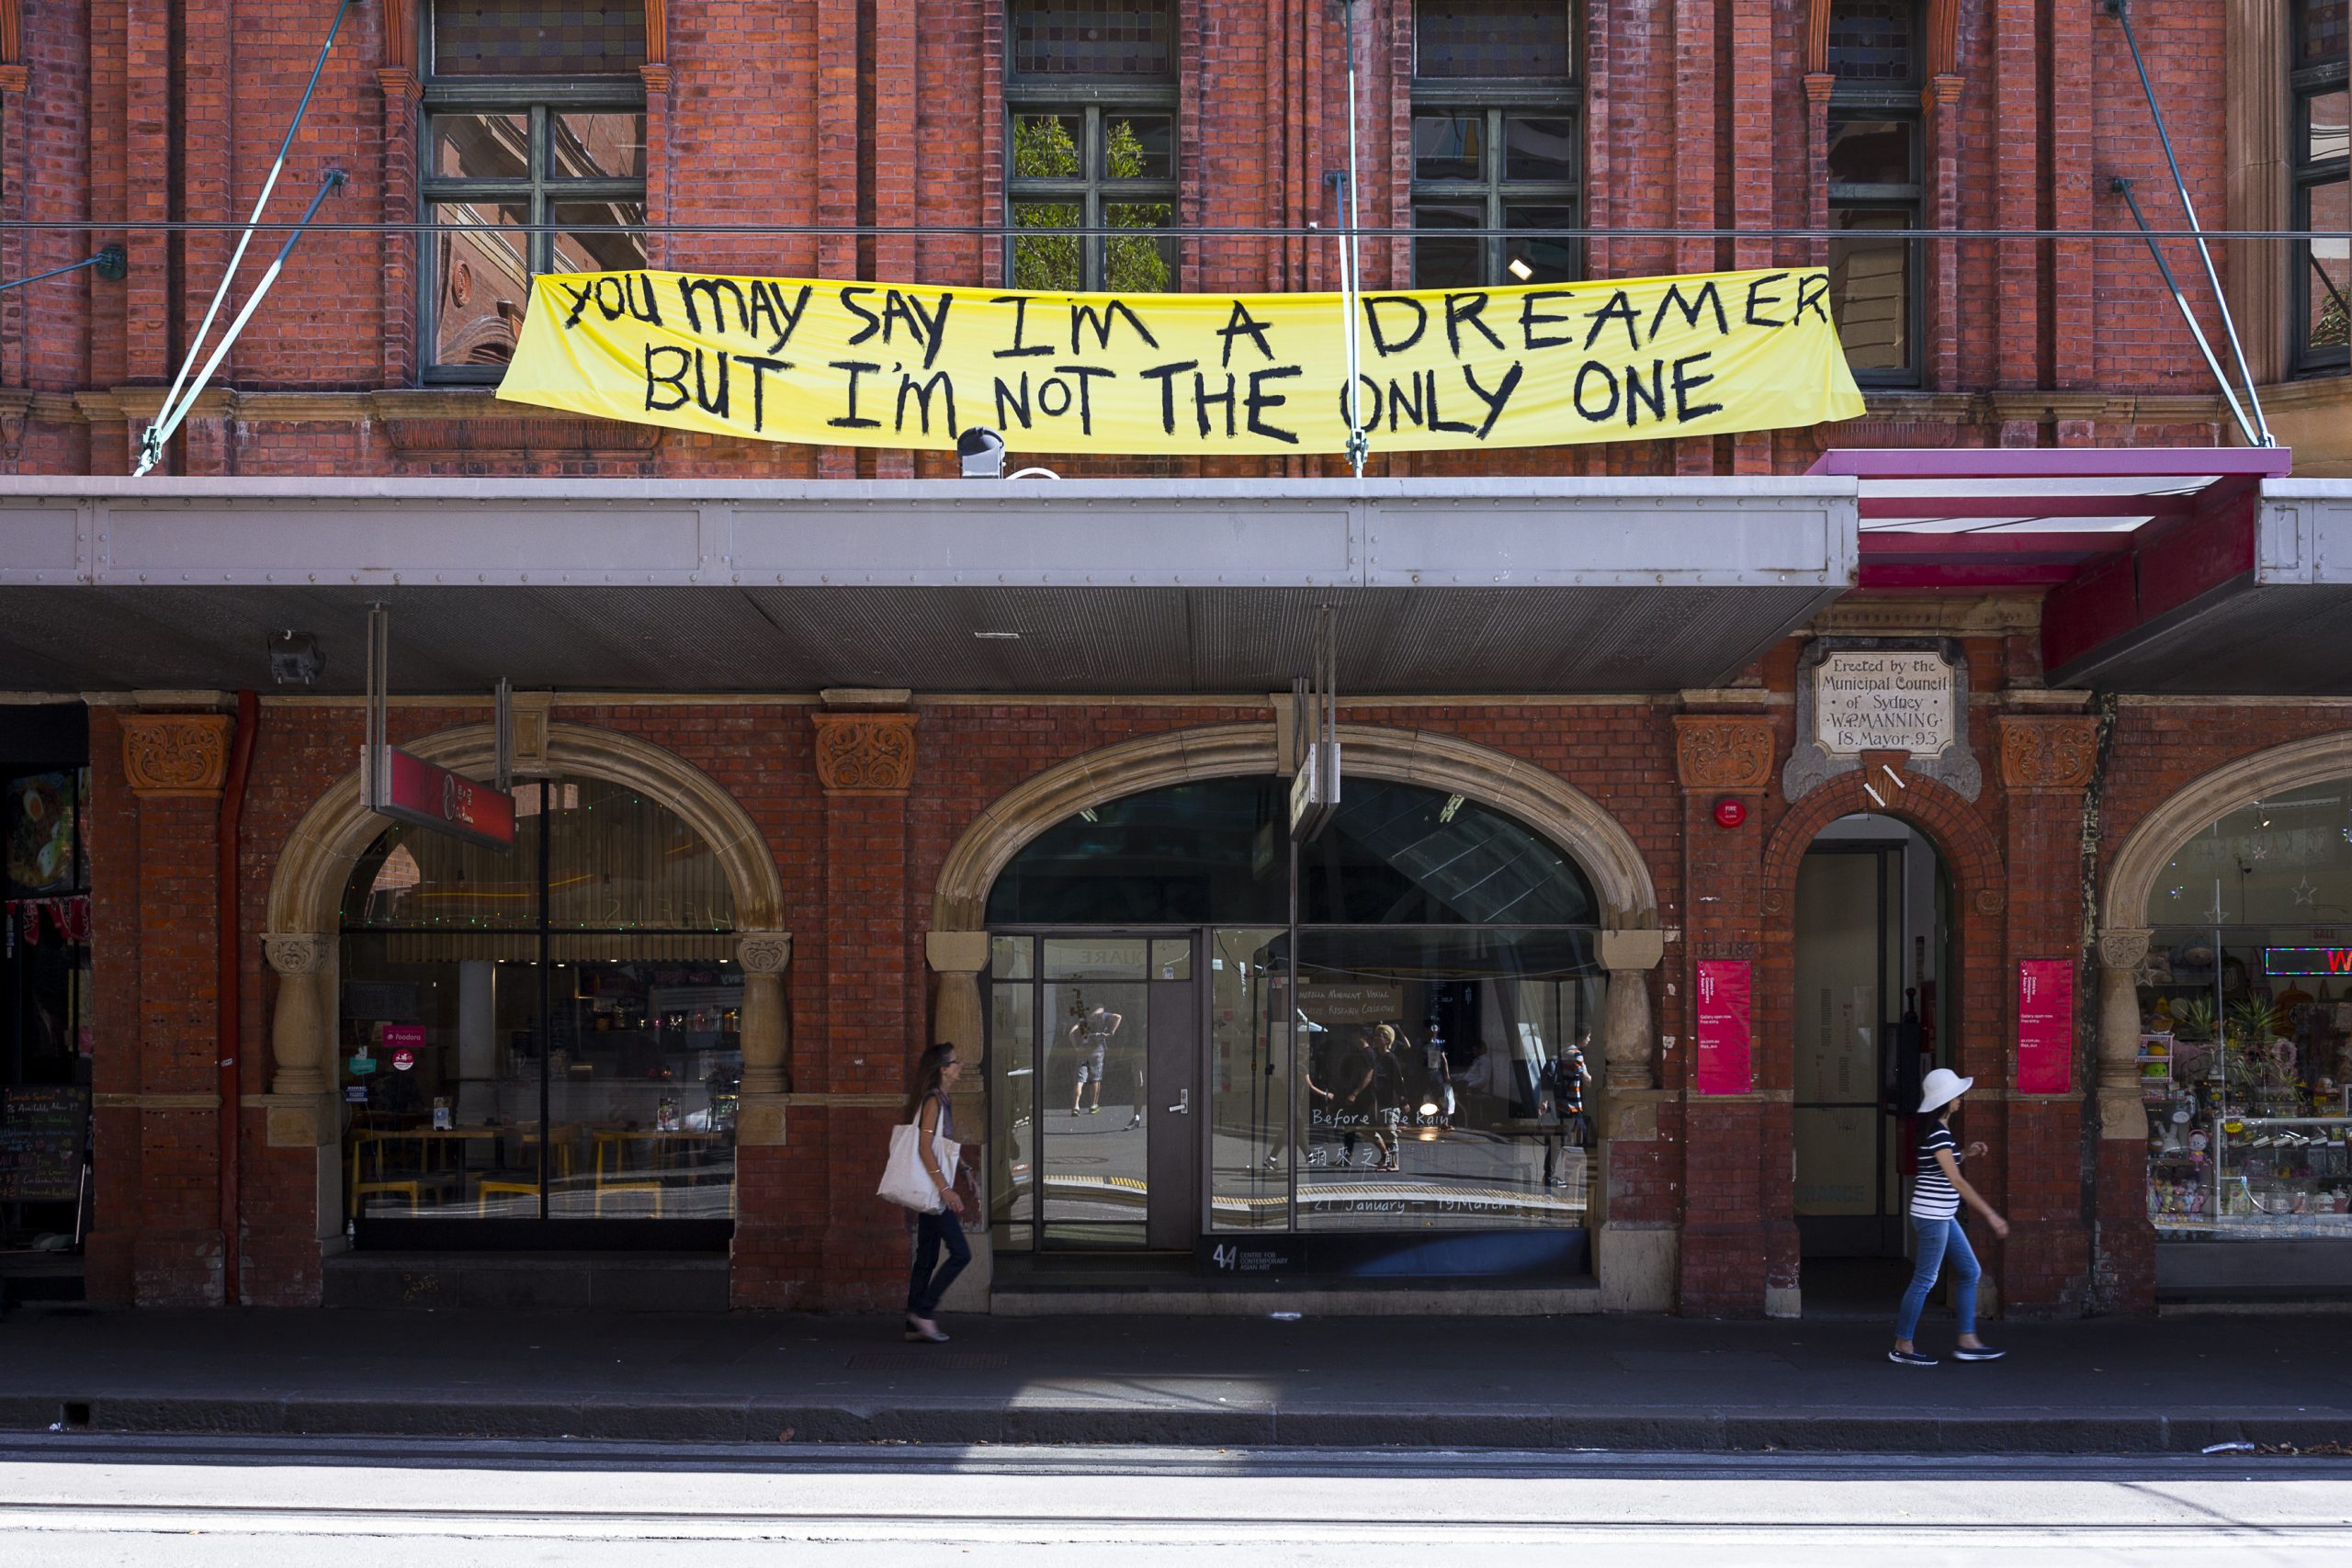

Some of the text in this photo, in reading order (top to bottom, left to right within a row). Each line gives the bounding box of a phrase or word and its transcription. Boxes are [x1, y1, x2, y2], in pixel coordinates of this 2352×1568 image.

[560, 273, 1830, 368] YOU MAY SAY I'M A DREAMER
[645, 343, 1724, 444] BUT I'M NOT THE ONLY ONE
[1834, 659, 1937, 675] Erected by the
[1822, 675, 1947, 695] Municipal Council
[1847, 694, 1924, 712] of Sydney
[2313, 928, 2335, 940] SALE
[1312, 1107, 1449, 1128] Before Te Rain
[1345, 1200, 1406, 1214] January
